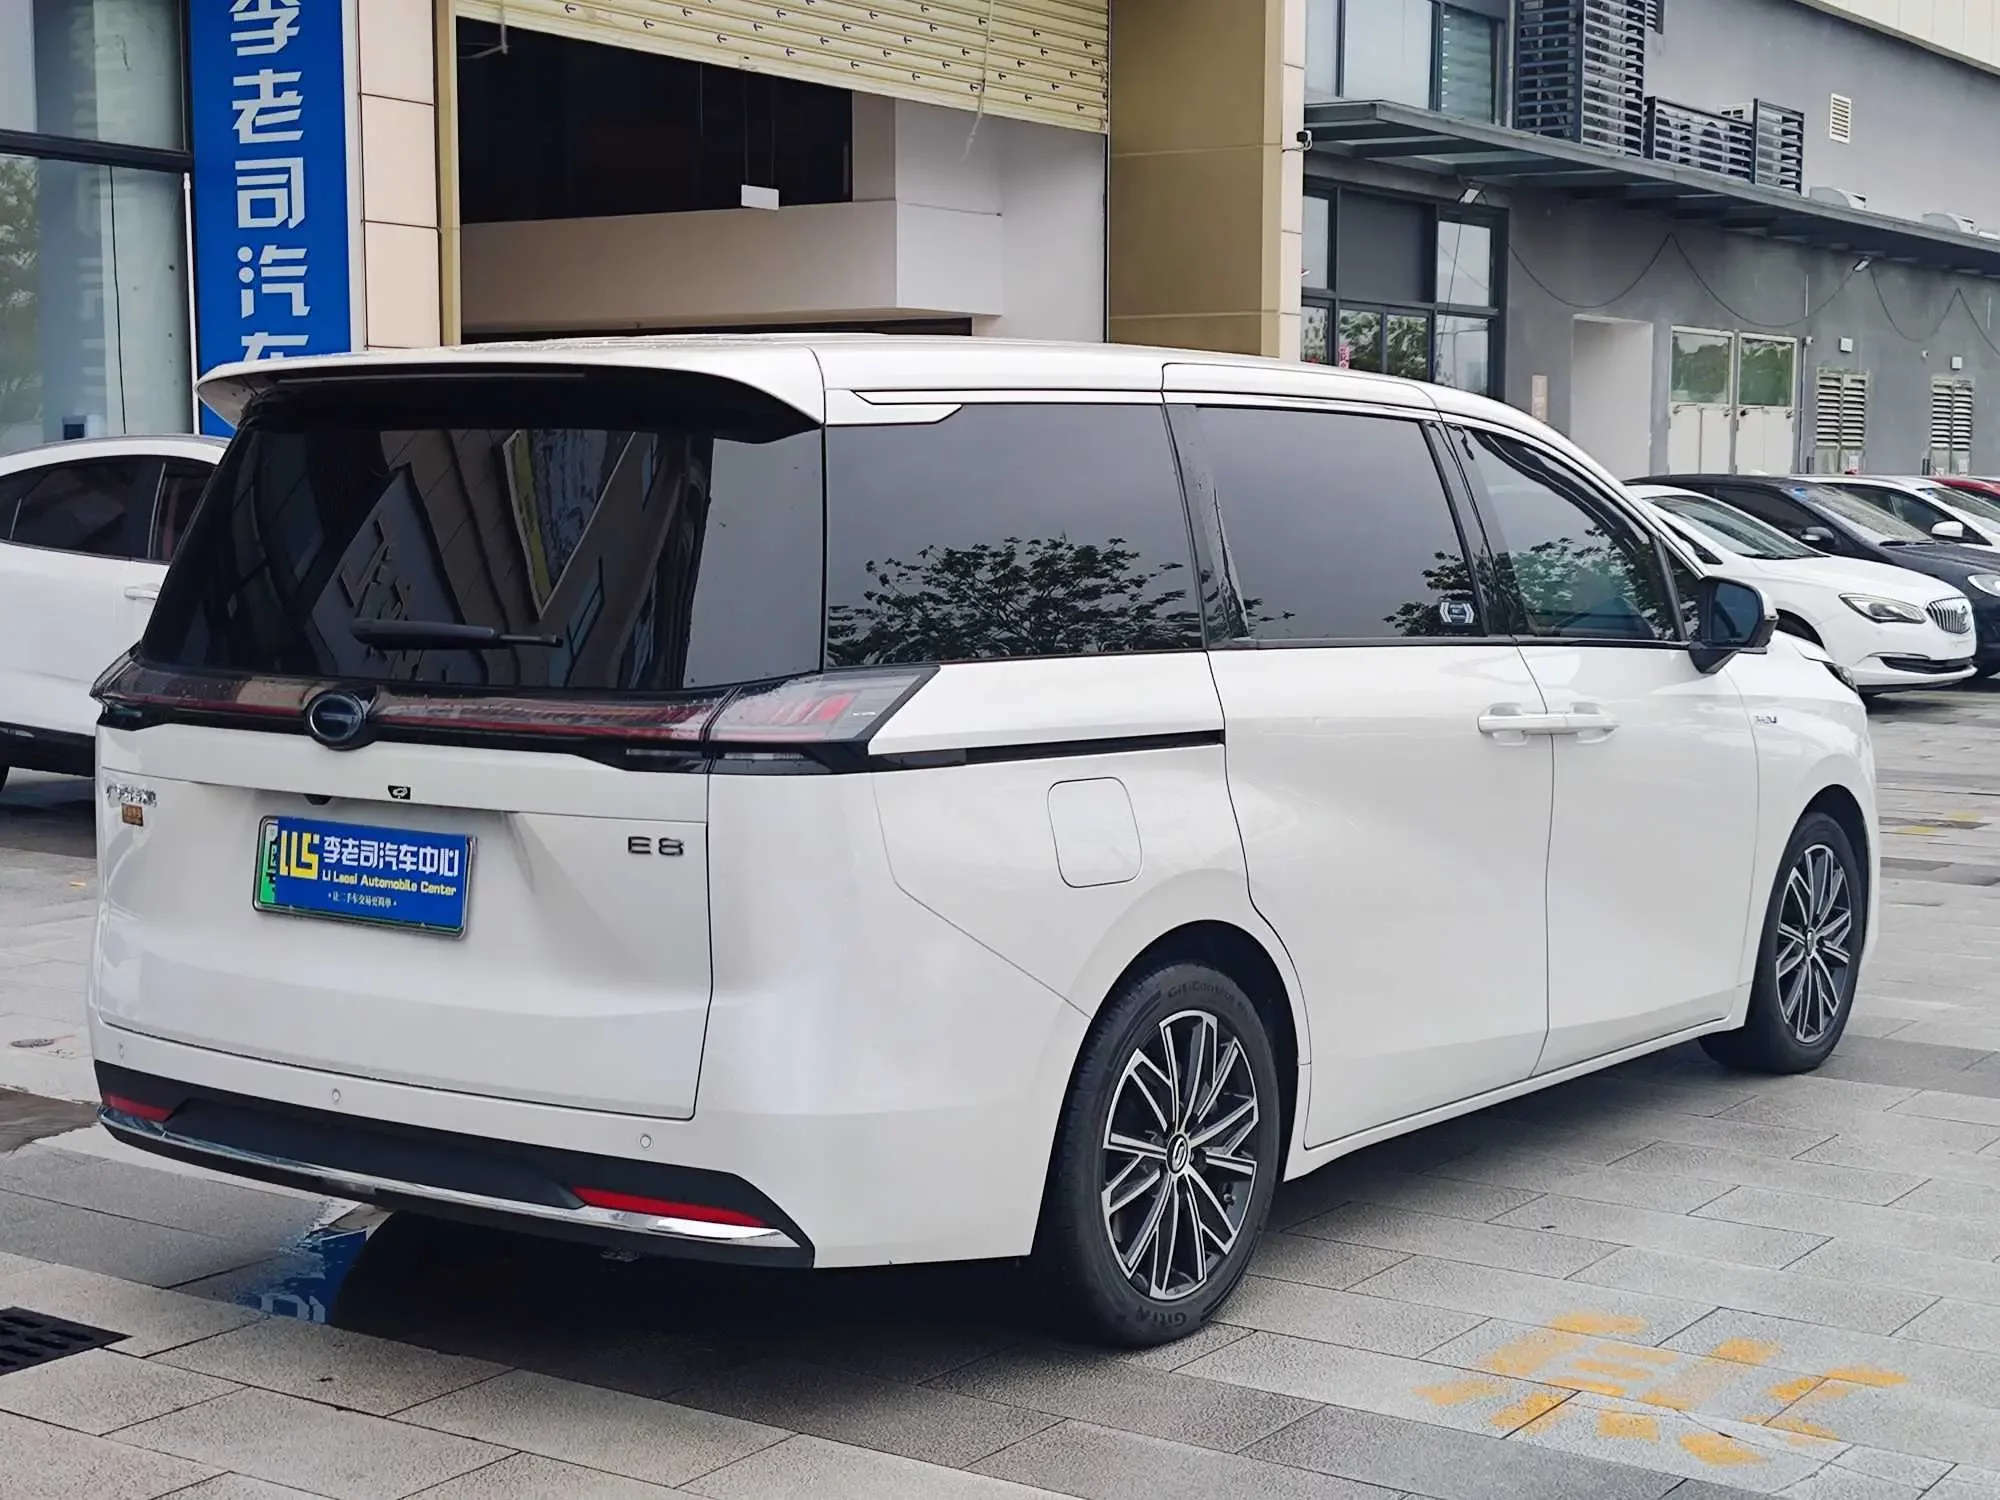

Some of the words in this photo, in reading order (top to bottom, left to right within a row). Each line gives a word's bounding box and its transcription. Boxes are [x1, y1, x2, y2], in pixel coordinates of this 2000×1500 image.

[323, 836, 459, 877] 李老司汽车中心
[628, 836, 683, 856] E8
[360, 874, 418, 893] Automobile
[420, 881, 457, 897] Center
